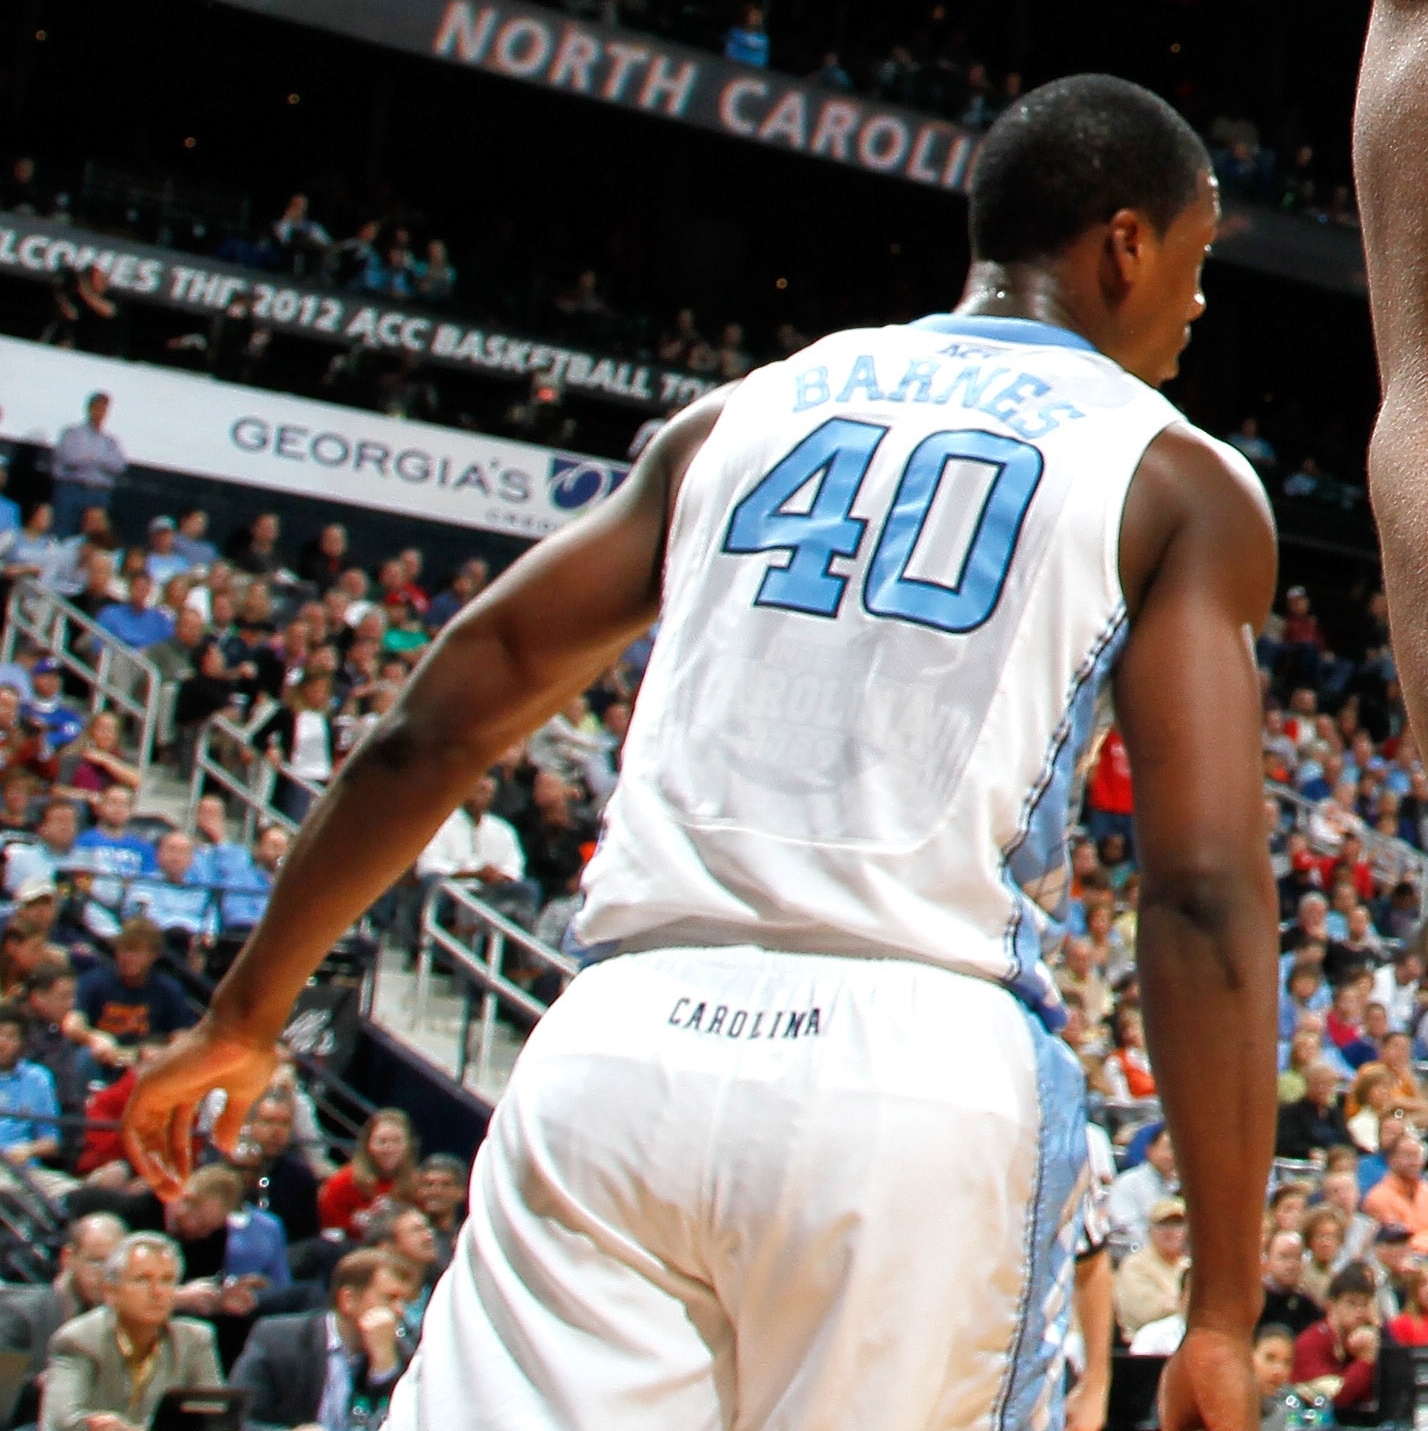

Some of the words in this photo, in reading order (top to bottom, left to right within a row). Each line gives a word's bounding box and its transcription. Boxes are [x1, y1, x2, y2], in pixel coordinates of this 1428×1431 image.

[718, 78, 980, 193] CAROLI
[250, 281, 345, 334] 2012
[346, 305, 432, 352] ACC
[430, 323, 652, 400] BASKETBALL
[792, 354, 1086, 441] BARNES
[229, 416, 530, 503] GEORGIA'S
[721, 415, 1045, 636] 40
[668, 997, 821, 1040] CAROLINA
